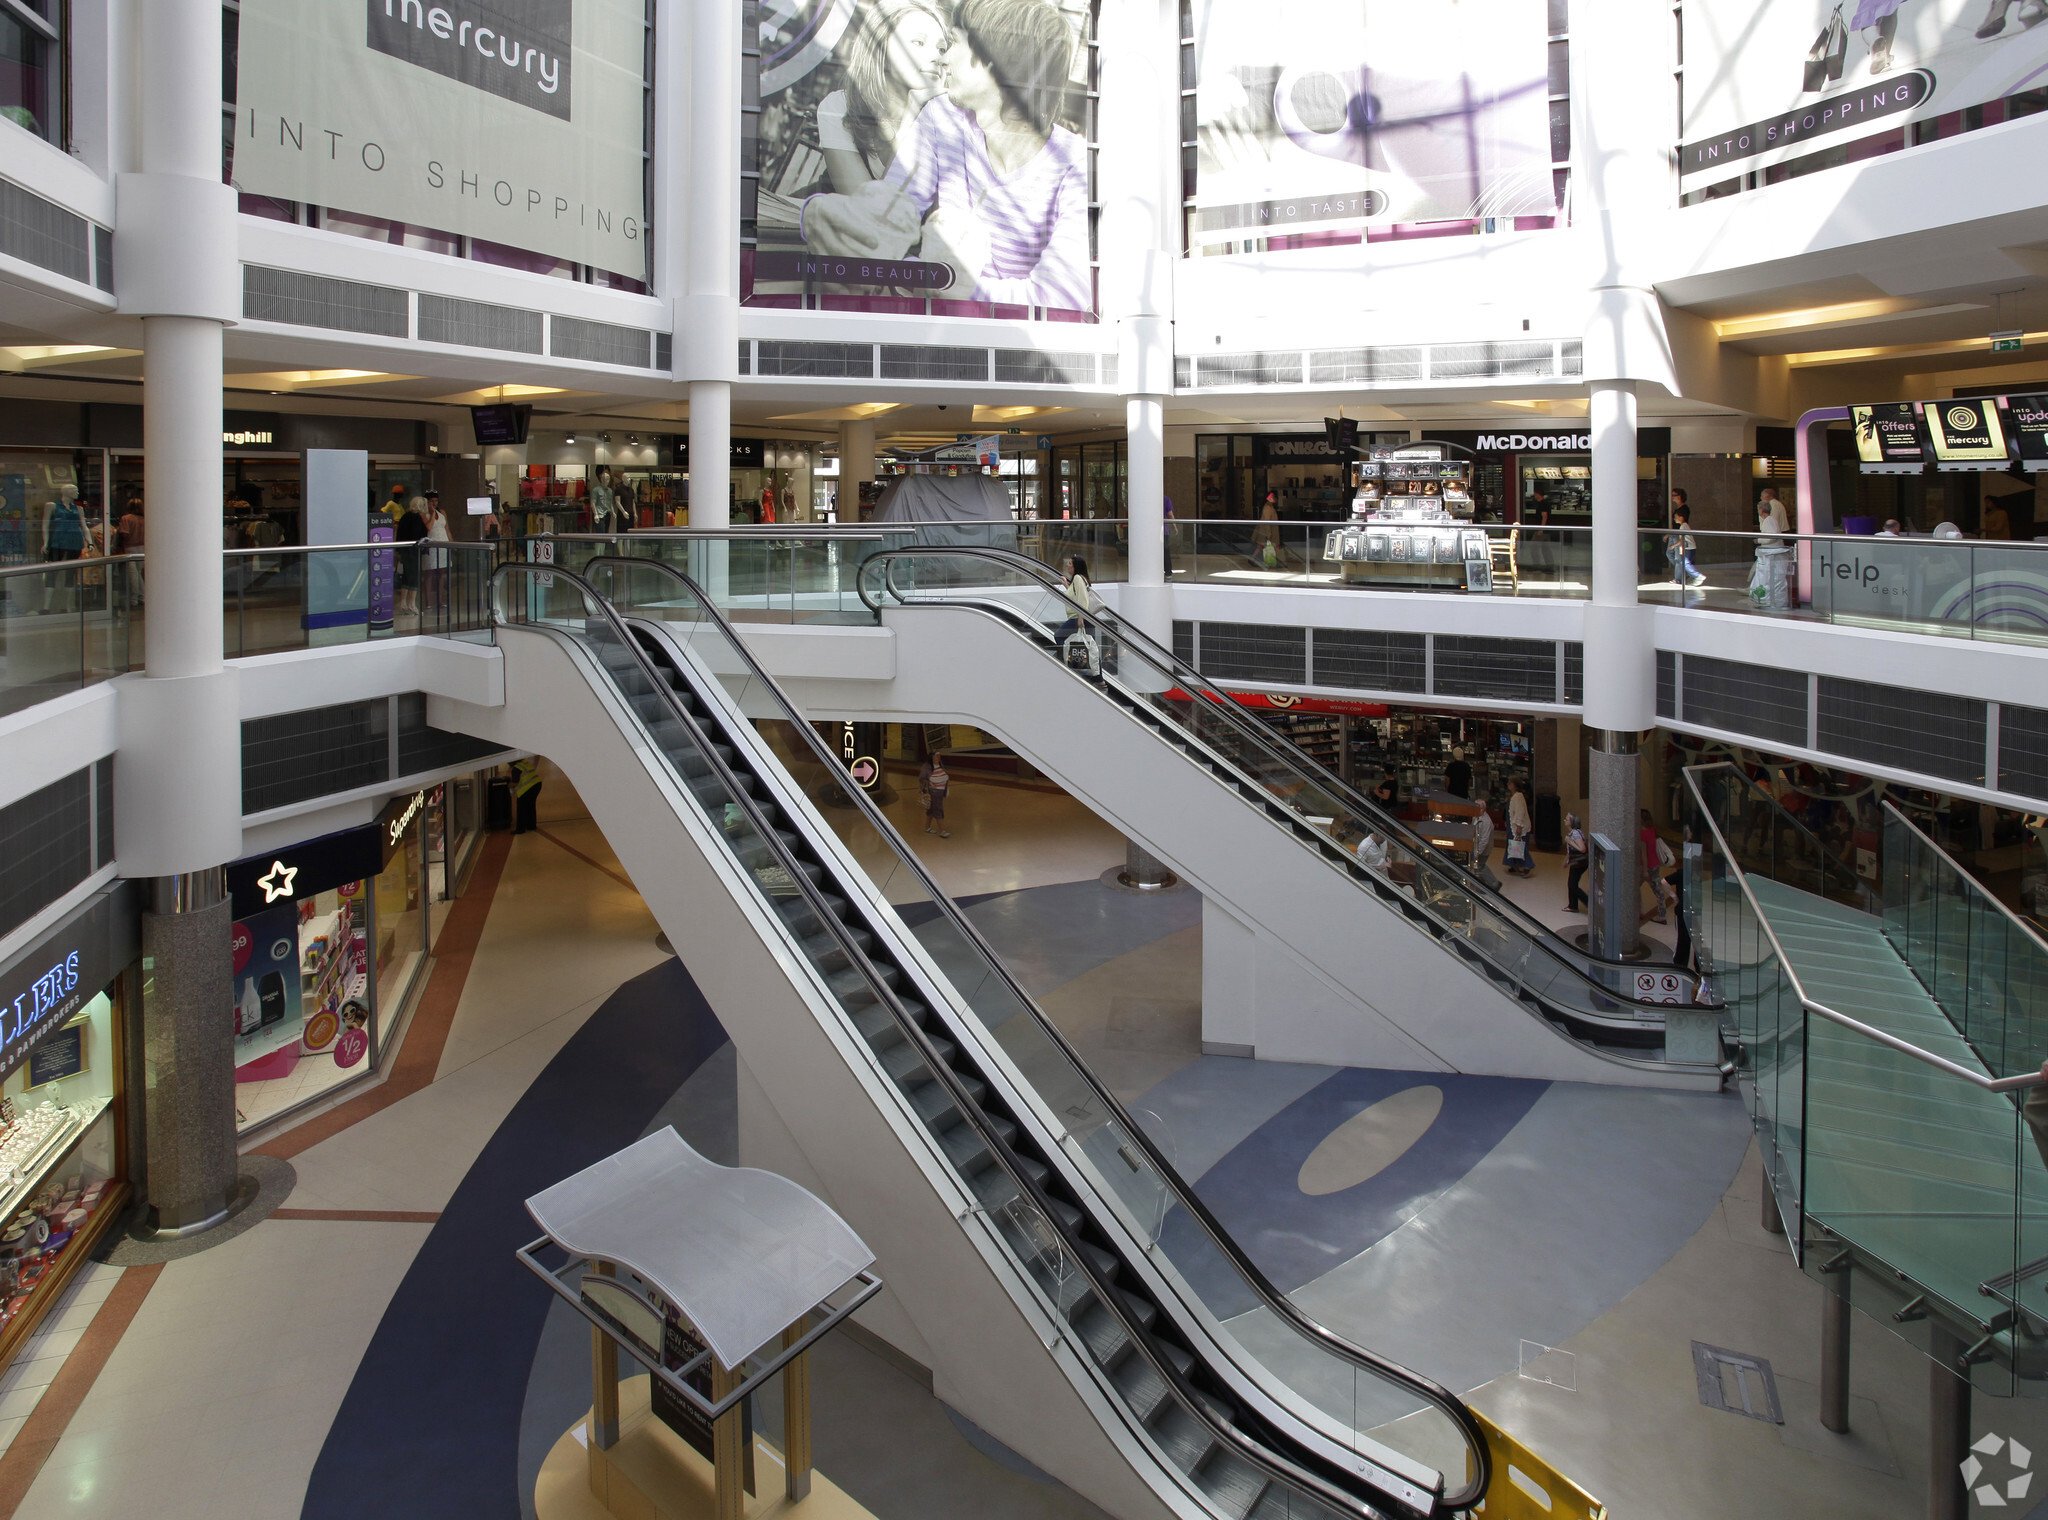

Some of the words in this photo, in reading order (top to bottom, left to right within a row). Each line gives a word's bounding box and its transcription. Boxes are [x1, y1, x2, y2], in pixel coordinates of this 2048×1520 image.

[385, 0, 559, 94] mercury
[1699, 135, 1750, 161] INTO
[1767, 85, 1909, 140] SHOPPING
[250, 108, 385, 171] INTO
[427, 161, 638, 240] SHOPPING
[1252, 205, 1297, 220] INTO
[1311, 198, 1372, 214] TASTE
[797, 262, 846, 276] INTO
[861, 266, 939, 281] BEAUTY
[1881, 421, 1916, 431] offers
[1947, 436, 1990, 445] mercury
[1408, 481, 1422, 493] £20
[1820, 555, 1880, 587] help
[1872, 584, 1909, 596] desk
[16, 994, 81, 1059] PAWNBROKERS
